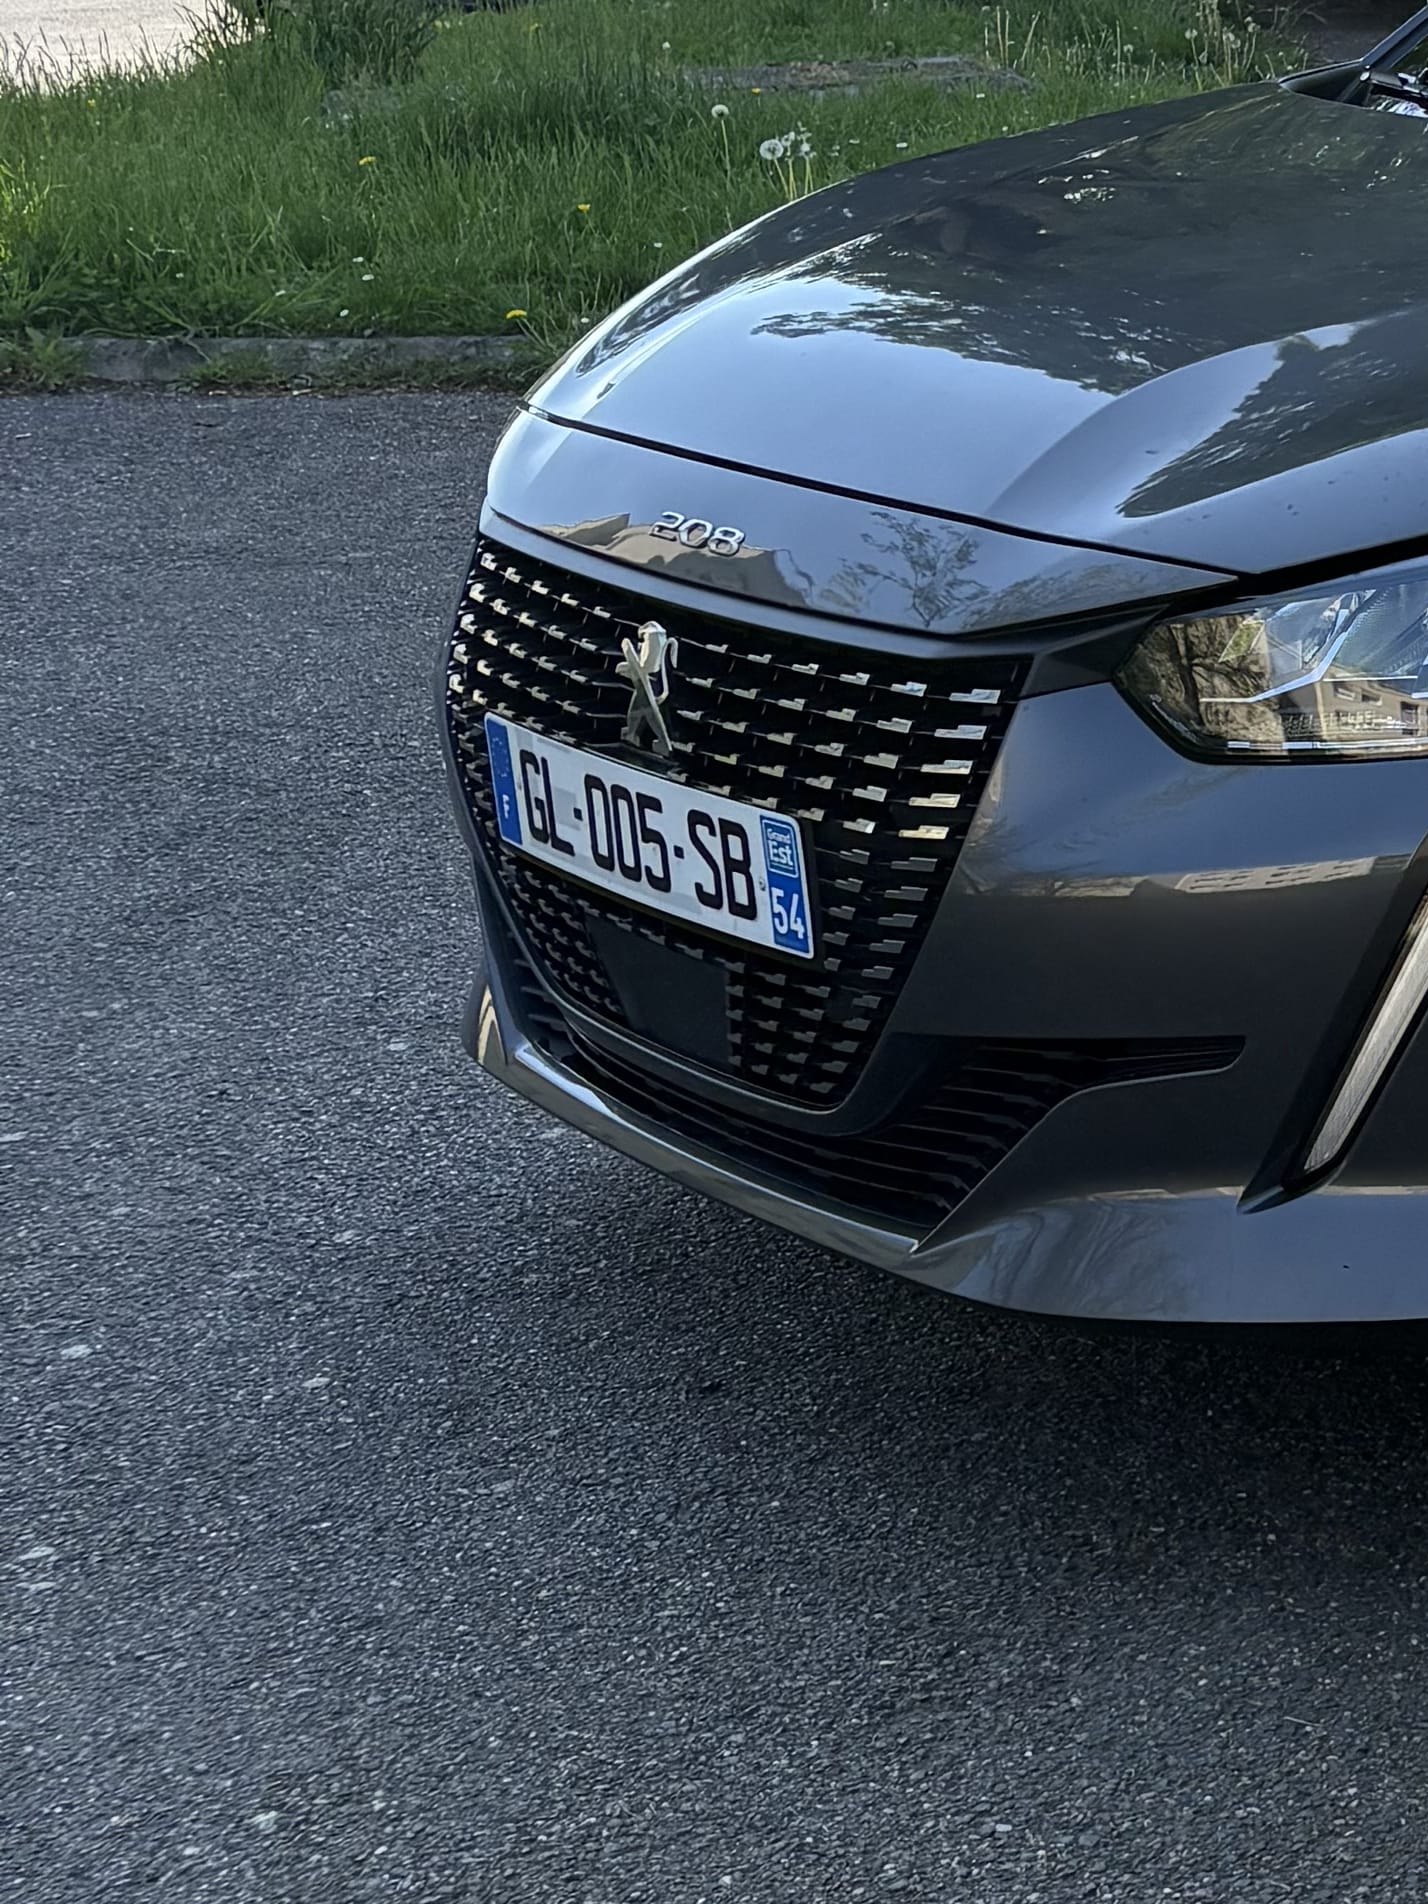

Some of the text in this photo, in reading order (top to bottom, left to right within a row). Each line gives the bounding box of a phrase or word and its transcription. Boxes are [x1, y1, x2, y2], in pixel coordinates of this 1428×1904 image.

[648, 511, 745, 557] 208
[518, 749, 758, 921] GL-005-SB
[768, 840, 793, 866] Est
[771, 887, 805, 940] 54
